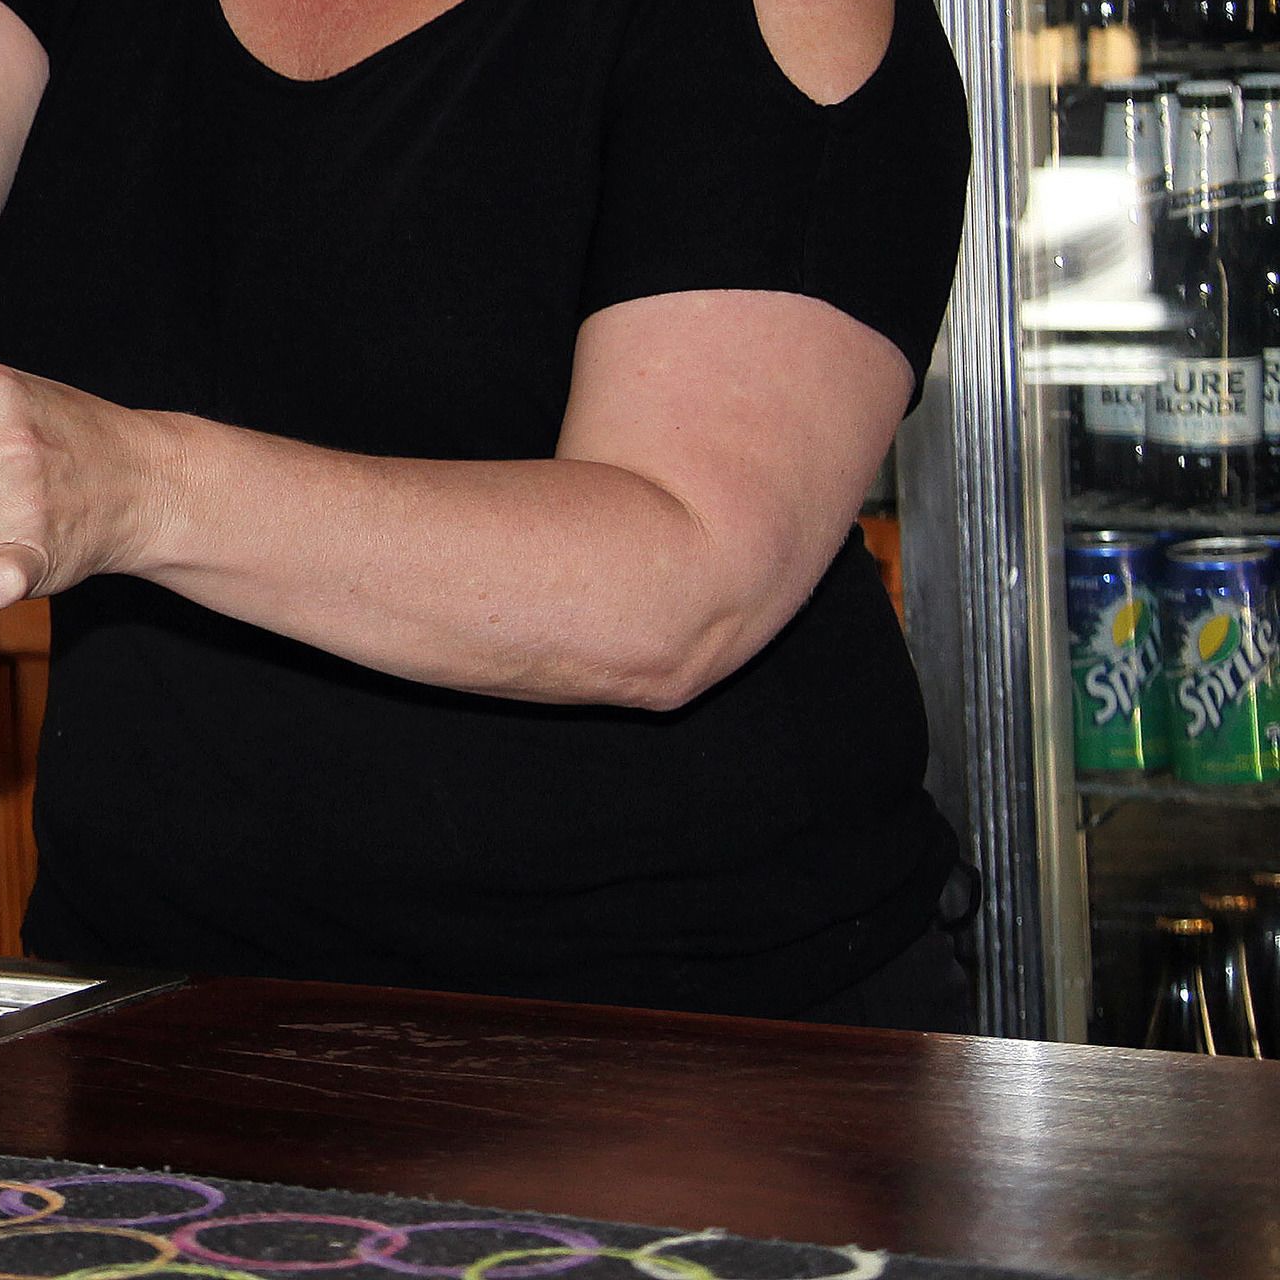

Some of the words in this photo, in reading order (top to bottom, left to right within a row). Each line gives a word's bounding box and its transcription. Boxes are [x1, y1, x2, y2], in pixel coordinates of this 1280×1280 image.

[1170, 369, 1246, 395] URE
[1156, 392, 1247, 417] BLONDE
[1179, 618, 1276, 738] Sprite
